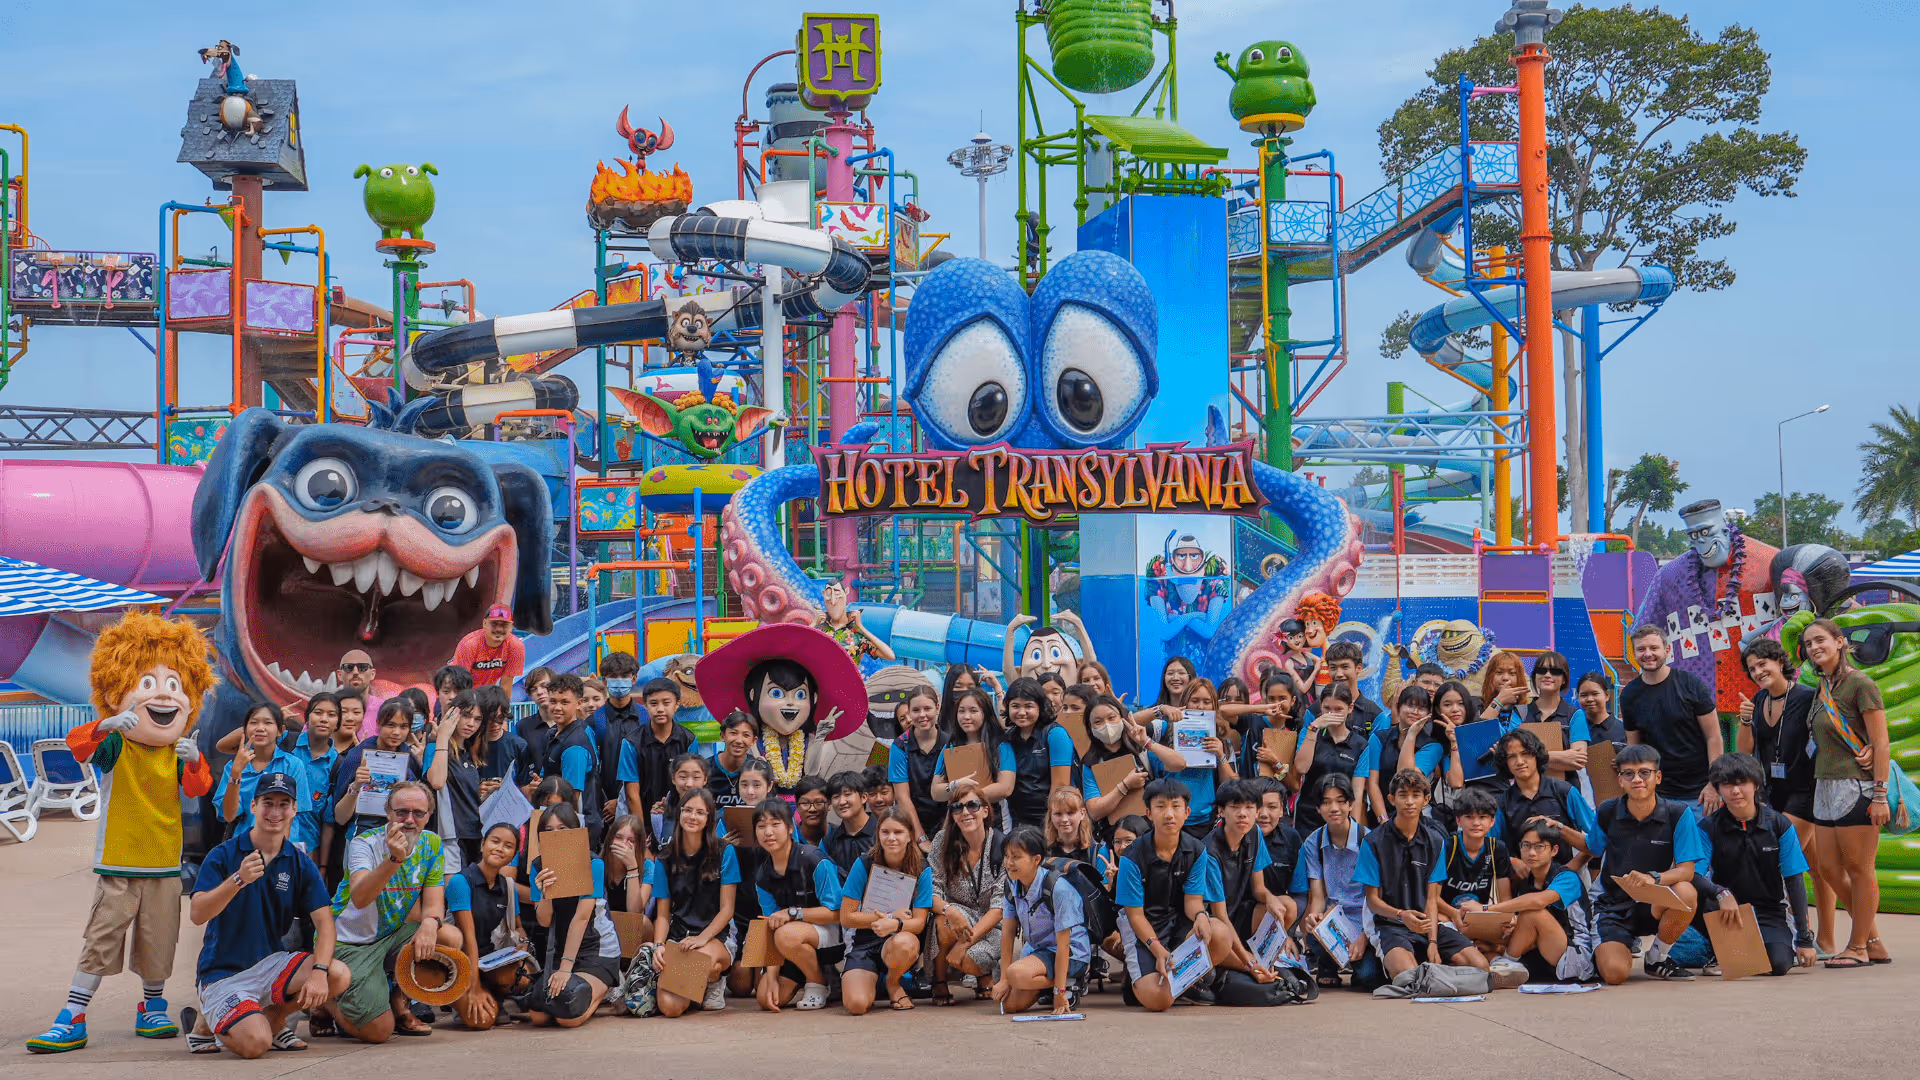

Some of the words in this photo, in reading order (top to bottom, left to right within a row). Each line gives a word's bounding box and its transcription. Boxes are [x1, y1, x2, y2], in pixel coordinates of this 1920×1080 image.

[824, 449, 969, 515] HOTEL
[968, 446, 1257, 520] TRANSYLVANIA
[713, 795, 746, 805] ION
[1447, 877, 1489, 892] LIONS
